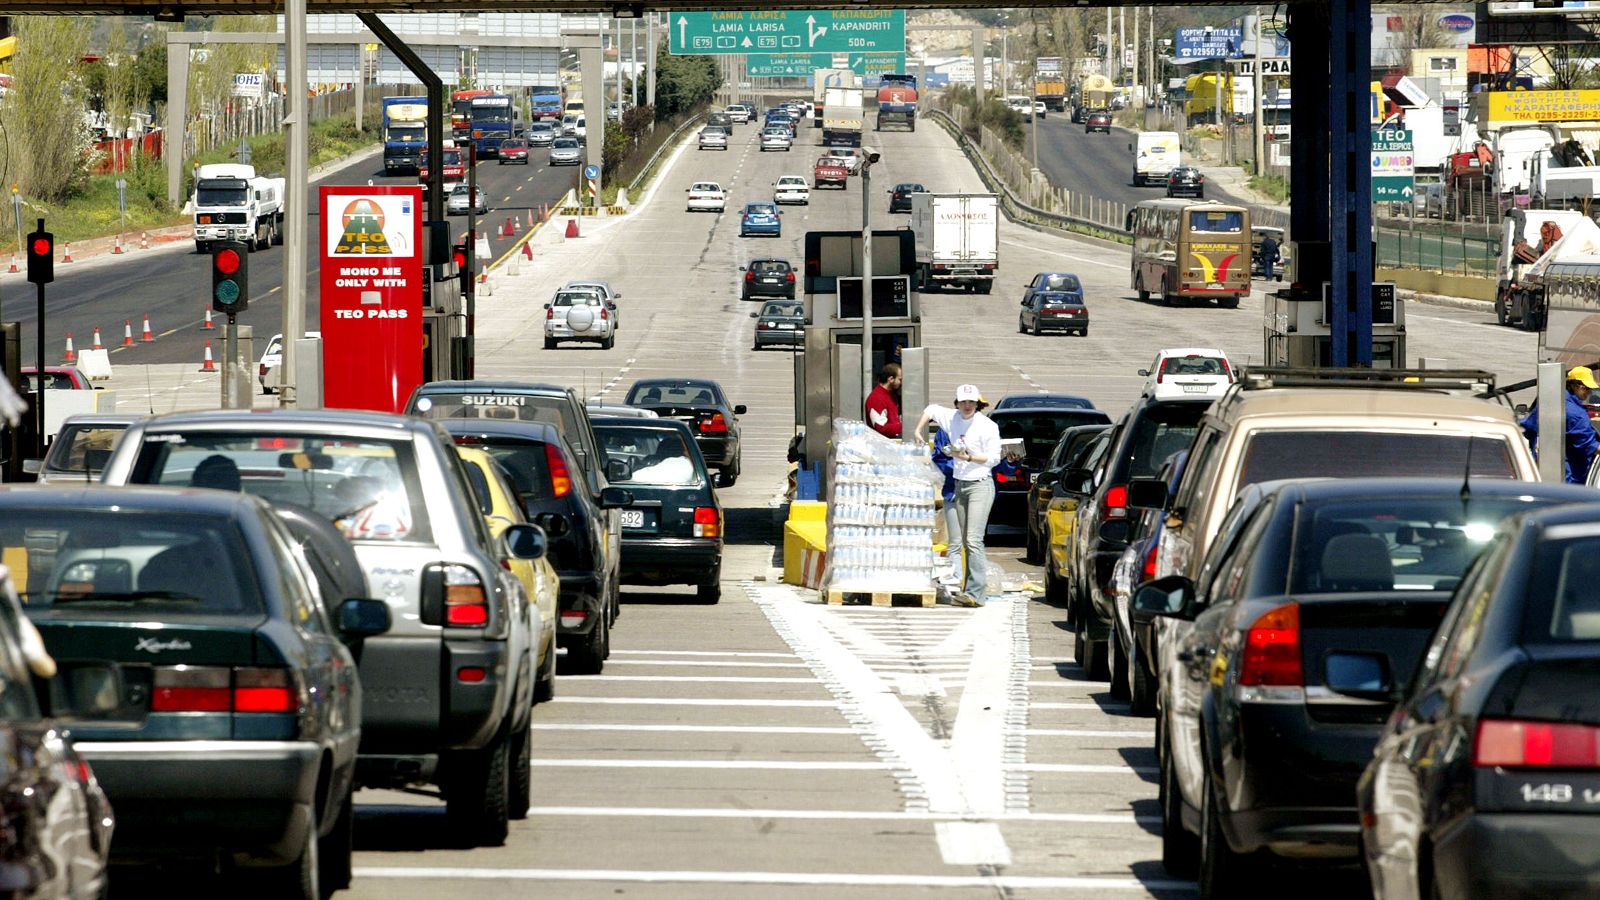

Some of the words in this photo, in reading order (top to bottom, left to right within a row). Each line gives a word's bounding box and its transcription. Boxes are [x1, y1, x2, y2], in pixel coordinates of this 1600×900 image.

[712, 23, 744, 33] LAMIA
[749, 23, 785, 32] LARISA
[832, 21, 891, 31] KAPANDRITI
[848, 38, 865, 47] 500
[1372, 156, 1412, 167] JUMBO
[1377, 186, 1386, 195] 14
[336, 245, 391, 253] PASS
[335, 278, 369, 287] ONLY
[372, 278, 407, 287] WITH
[334, 309, 365, 319] TEO
[367, 309, 408, 319] PASS
[462, 395, 526, 406] SUZUKI
